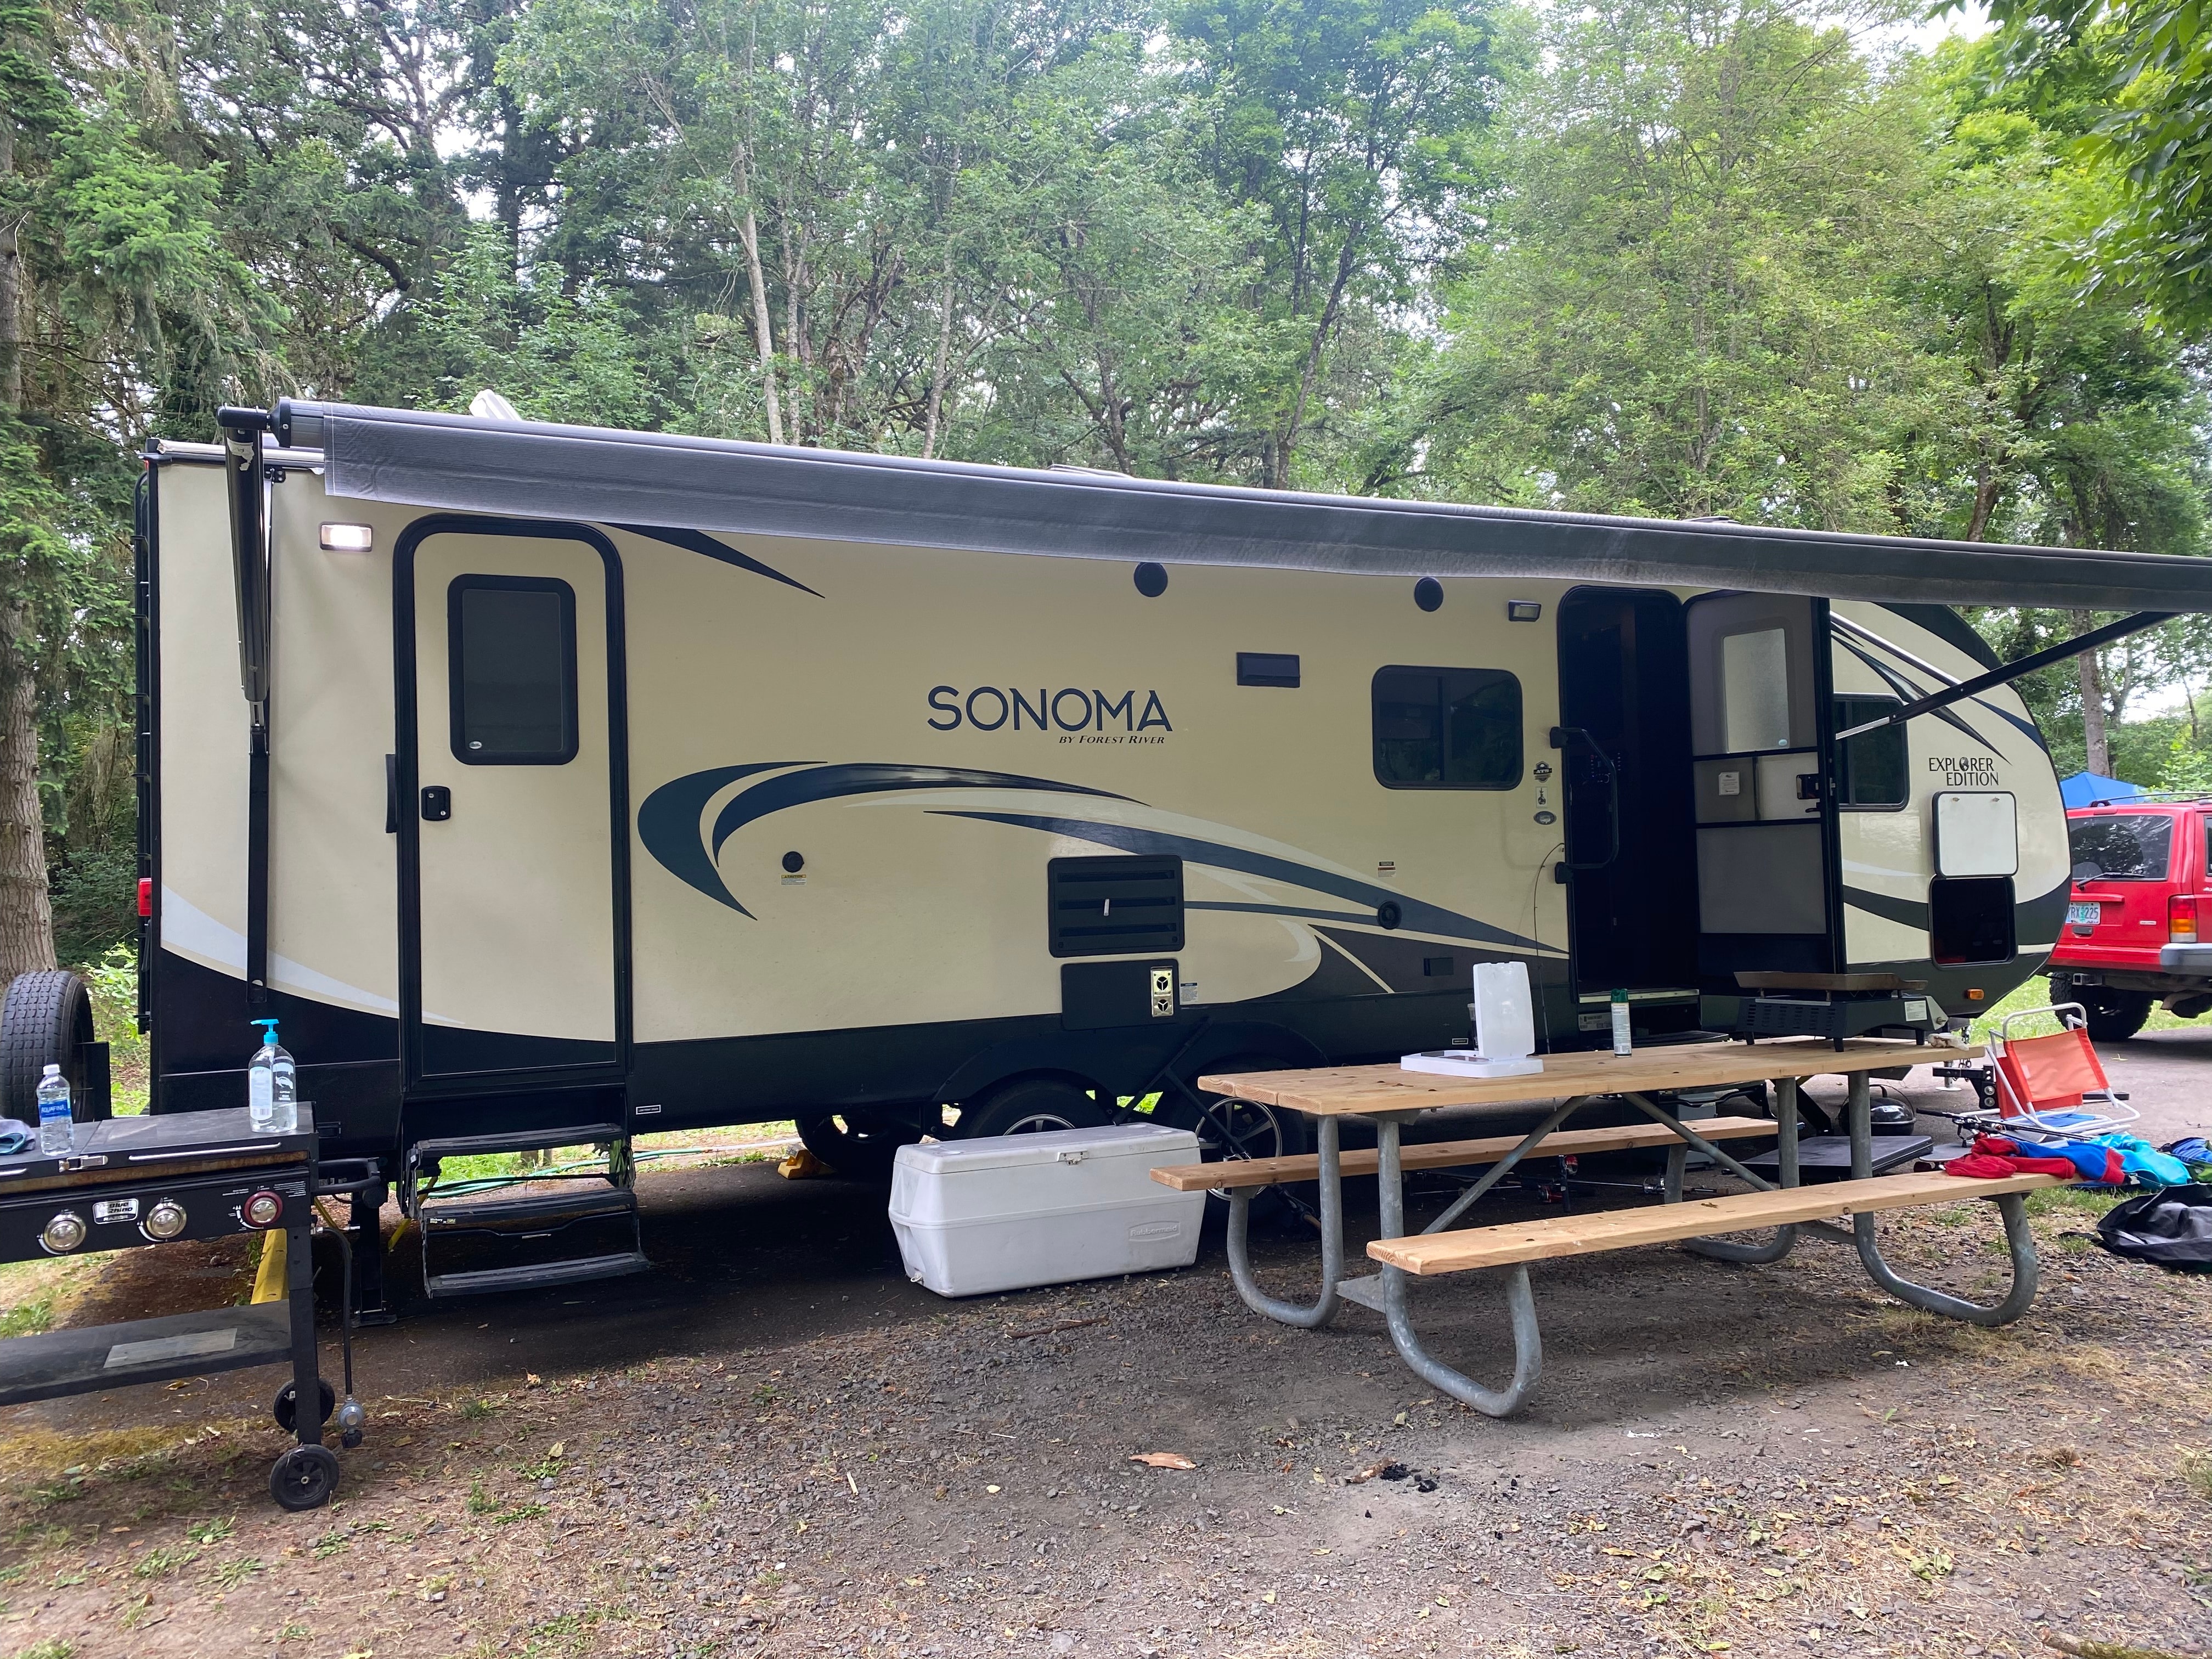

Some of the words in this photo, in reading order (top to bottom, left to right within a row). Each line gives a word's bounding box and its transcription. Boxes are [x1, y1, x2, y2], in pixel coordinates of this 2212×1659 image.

[927, 685, 1173, 731] SONOMA
[1079, 735, 1126, 744] FOREST
[1128, 735, 1165, 744] RIVER
[1928, 757, 1994, 771] EXPLORER
[1946, 772, 1999, 786] EDITION
[2085, 907, 2098, 919] 225
[41, 1104, 66, 1113] AQUAFINA
[1130, 1224, 1177, 1237] Rubbermaid
